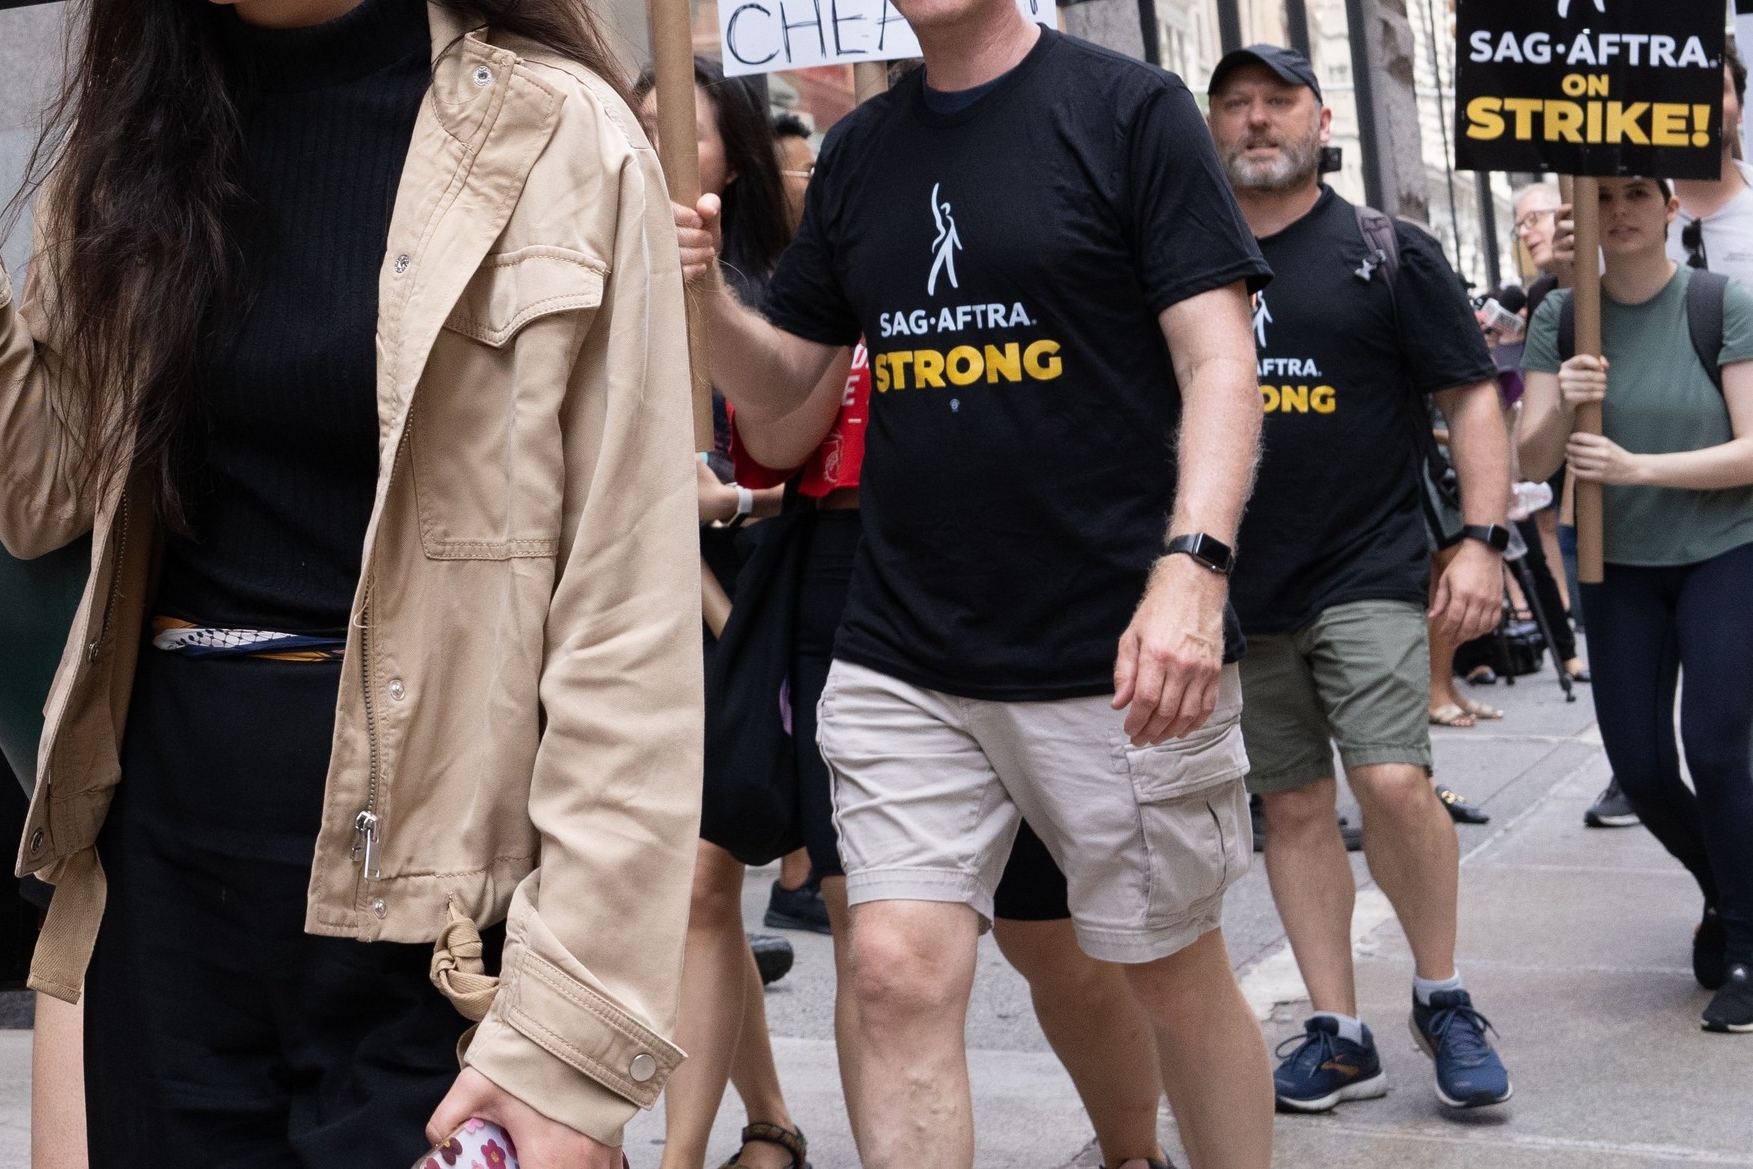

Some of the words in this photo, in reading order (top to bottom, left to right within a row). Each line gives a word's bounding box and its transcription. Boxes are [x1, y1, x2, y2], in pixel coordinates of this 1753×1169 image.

[1562, 73, 1610, 97] ON
[1466, 96, 1711, 148] STRIKE!
[875, 339, 1063, 393] STRONG
